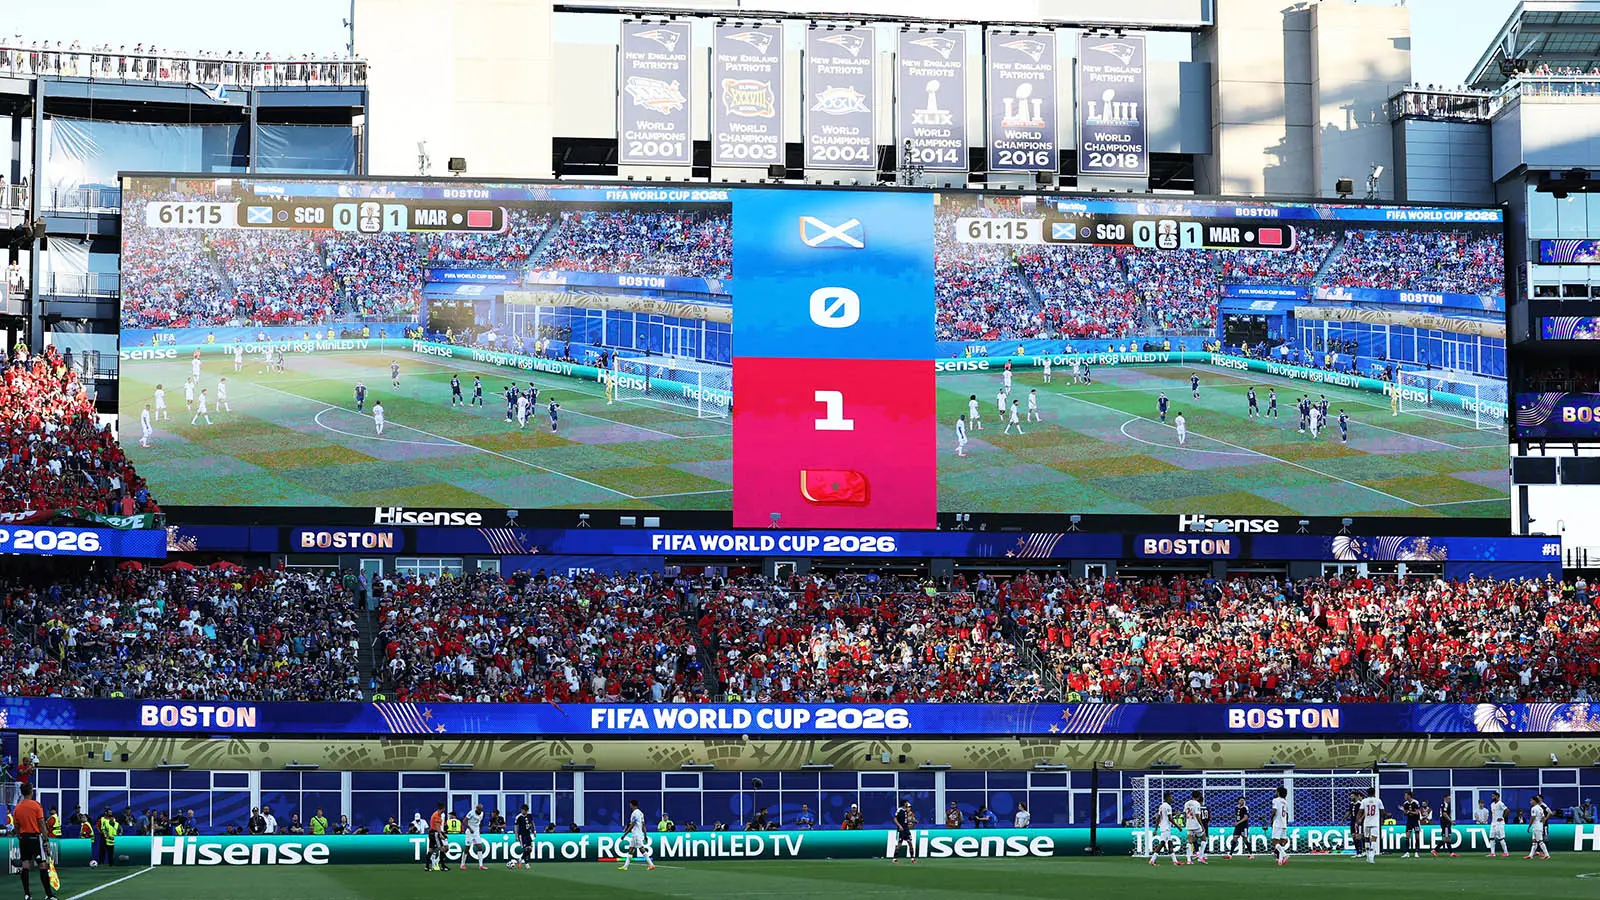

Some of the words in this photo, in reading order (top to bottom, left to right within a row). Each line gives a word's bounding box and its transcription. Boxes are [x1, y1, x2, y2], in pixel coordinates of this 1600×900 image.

[633, 60, 680, 70] PATRIOTS
[725, 63, 771, 72] PATRIOTS
[818, 65, 863, 74] PATRIOTS
[1104, 66, 1141, 74] ENGLAND
[909, 68, 954, 77] PATRIOTS
[1000, 71, 1045, 80] PATRIOTS
[1090, 73, 1135, 82] PATRIOTS
[636, 120, 674, 130] WORLD
[912, 112, 953, 125] XLIX
[729, 123, 767, 132] WORLD
[822, 126, 859, 135] WORLD
[914, 128, 950, 137] WORLD
[625, 130, 686, 141] CHAMPIONS
[719, 133, 778, 143] CHAMPIONS
[812, 135, 870, 145] CHAMPIONS
[1005, 131, 1041, 140] WORLD
[1095, 133, 1131, 142] WORLD
[629, 142, 682, 156] 2001
[720, 144, 777, 159] 2003
[994, 140, 1052, 150] CHAMPIONS
[1084, 143, 1142, 152] CHAMPIONS
[812, 146, 869, 161] 2004
[911, 148, 958, 163] 2014
[998, 151, 1049, 165] 2016
[1089, 153, 1138, 167] 2018
[444, 190, 488, 198] BOSTON
[606, 191, 627, 200] FIFA
[630, 191, 667, 200] WORLD
[668, 192, 690, 200] CUP
[159, 205, 222, 224] 61:15
[294, 207, 324, 223] SCO
[340, 209, 351, 225] 0
[390, 210, 398, 226] 1
[415, 210, 447, 226] MAR
[1236, 208, 1278, 216] BOSTON
[1386, 211, 1405, 220] FIFA
[1408, 211, 1442, 220] WORLD
[1444, 212, 1463, 220] CUP
[968, 221, 1028, 240] 61:15
[1096, 224, 1125, 240] SCO
[1139, 226, 1149, 242] 0
[1186, 228, 1195, 243] 1
[1210, 227, 1239, 243] MAR
[619, 276, 665, 288] BOSTON
[1400, 293, 1443, 304] BOSTON
[810, 287, 860, 328] 0
[316, 340, 354, 350] MiniLED
[357, 340, 368, 349] TV
[412, 341, 452, 357] Hisense
[472, 350, 485, 361] The
[486, 352, 508, 366] Origin
[563, 364, 572, 375] TV
[1099, 354, 1119, 364] RGB
[1120, 354, 1156, 363] MiniLED
[1159, 354, 1169, 362] TV
[1211, 353, 1248, 370] Hisense
[1266, 364, 1278, 374] The
[1279, 366, 1300, 378] Origin
[1350, 378, 1359, 388] TV
[814, 390, 854, 430] 1
[374, 507, 482, 526] Hisense
[14, 530, 100, 552] 2026
[301, 532, 393, 548] BOSTON
[652, 534, 698, 550] FIFA
[700, 535, 774, 551] WORLD
[783, 536, 821, 551] CUP
[824, 536, 895, 552] 2026
[1144, 539, 1230, 555] BOSTON
[141, 705, 256, 727] BOSTON
[592, 709, 648, 729] FIFA
[653, 709, 750, 729] WORLD
[757, 708, 810, 729] CUP
[815, 709, 909, 729] 2026
[1229, 709, 1339, 729] BOSTON
[1367, 805, 1376, 816] 18
[152, 837, 330, 865] Hisense
[561, 835, 590, 859] of
[660, 833, 764, 857] MiniLED
[774, 835, 803, 856] TV
